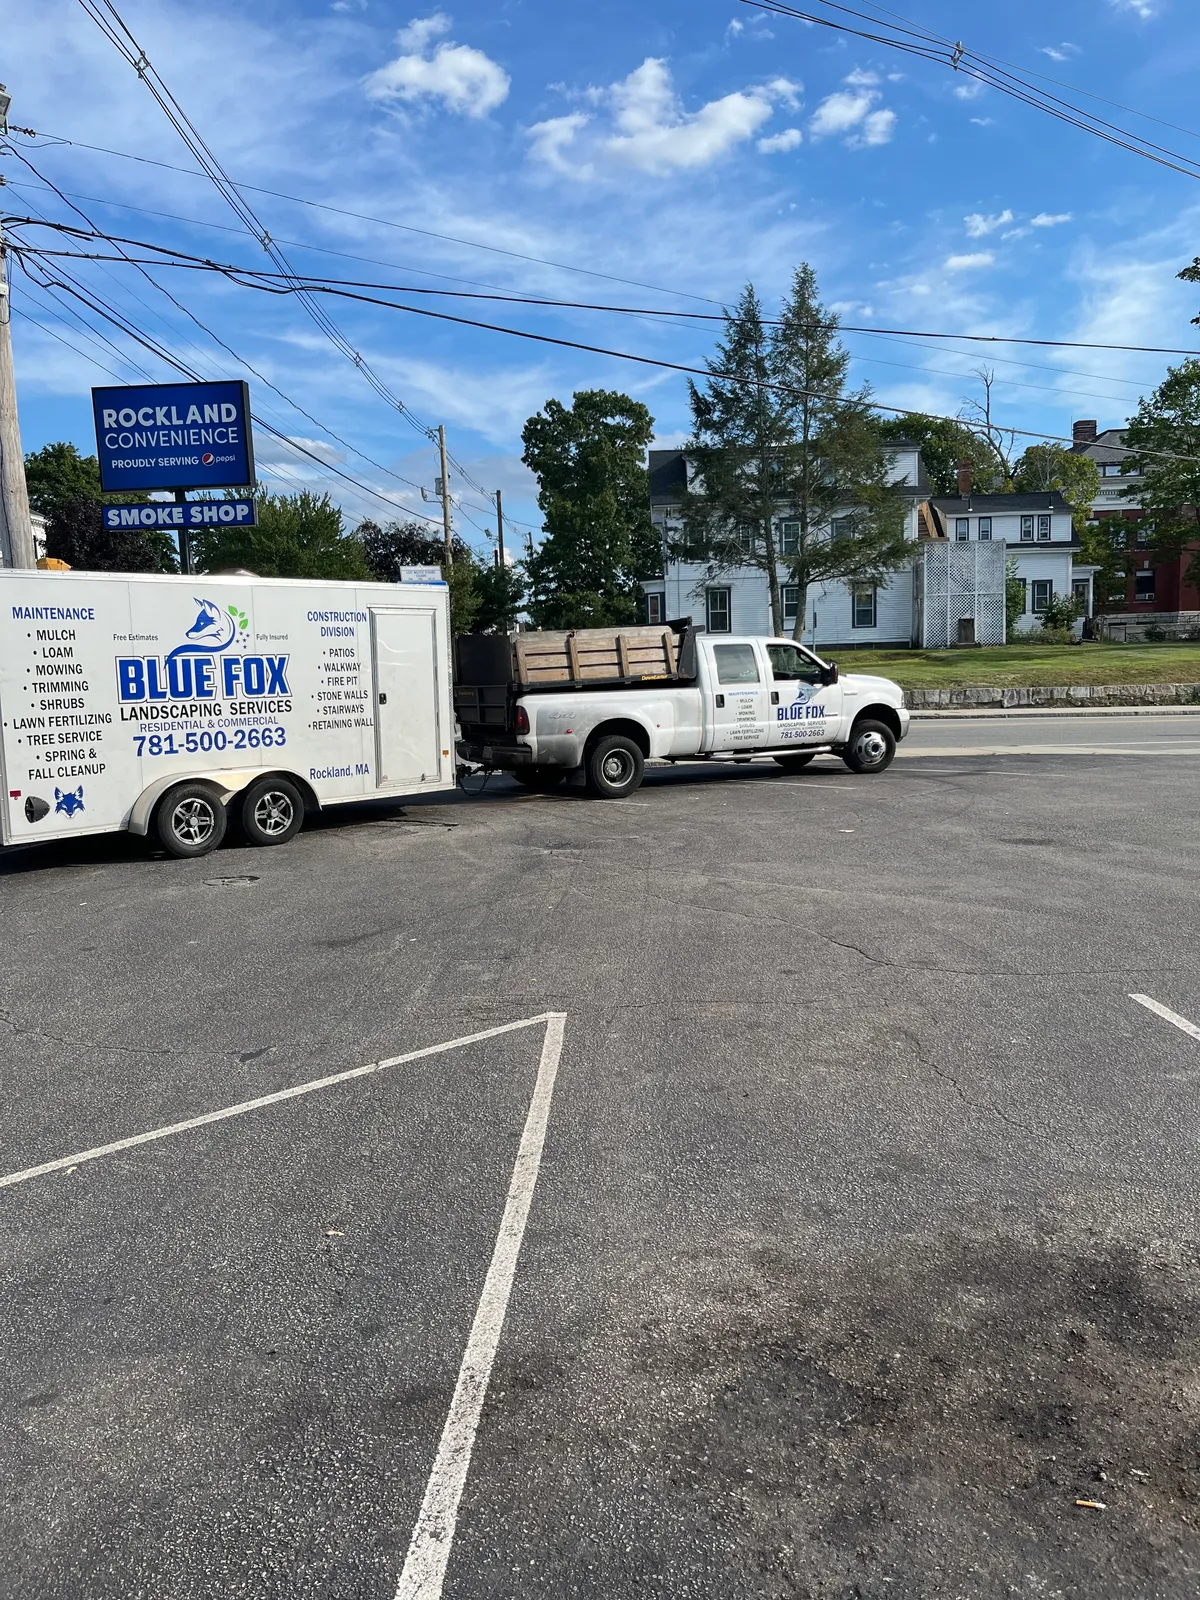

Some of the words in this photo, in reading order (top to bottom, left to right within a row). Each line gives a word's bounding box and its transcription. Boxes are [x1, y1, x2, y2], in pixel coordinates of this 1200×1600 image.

[103, 403, 237, 428] ROCKLAND
[105, 427, 238, 449] CONVENIENCE
[112, 459, 156, 468] PROUDLY
[158, 456, 199, 466] SERVING
[215, 454, 236, 463] pepsi
[108, 507, 184, 526] SMOKE
[190, 504, 249, 522] SHOP
[12, 606, 95, 620] MAINTENANCE
[307, 611, 367, 622] CONSTRUCTION
[36, 630, 76, 641] MULCH
[113, 633, 127, 641] Free
[256, 633, 268, 641] Fully
[321, 627, 354, 637] DIVISION
[42, 647, 74, 658] LOAM
[329, 648, 355, 657] PATIOS
[36, 664, 83, 676] MOWING
[324, 663, 361, 672] WALKWAY
[115, 655, 216, 704] BLUE
[221, 654, 292, 701] FOX
[327, 677, 344, 686] FIRE
[346, 676, 358, 685] PIT
[32, 681, 89, 693] TRIMMING
[317, 691, 342, 701] STONE
[344, 690, 368, 699] WALLS
[40, 699, 85, 710] SHRUBS
[120, 703, 222, 721] LANDSCAPING
[229, 700, 292, 716] SERVICES
[323, 704, 364, 715] STAIRWAYS
[778, 707, 803, 720] BLUE
[806, 706, 825, 718] FOX
[13, 717, 45, 730] LAWN
[48, 714, 112, 727] FERTILIZING
[139, 720, 205, 732] RESIDENTIAL
[207, 719, 215, 729] &
[217, 716, 279, 728] COMMERCIAL
[312, 719, 352, 730] RETAINING
[353, 718, 374, 727] WALL
[27, 734, 55, 746] TREE
[58, 731, 102, 744] SERVICE
[781, 730, 824, 738] 781-500-2663
[133, 727, 286, 757] 781-500-2663
[45, 750, 86, 762] SPRING
[88, 749, 97, 758] &
[28, 768, 55, 780] FALL
[57, 764, 106, 777] CLEANUP
[309, 765, 353, 779] Rockland,
[356, 764, 369, 775] MA
